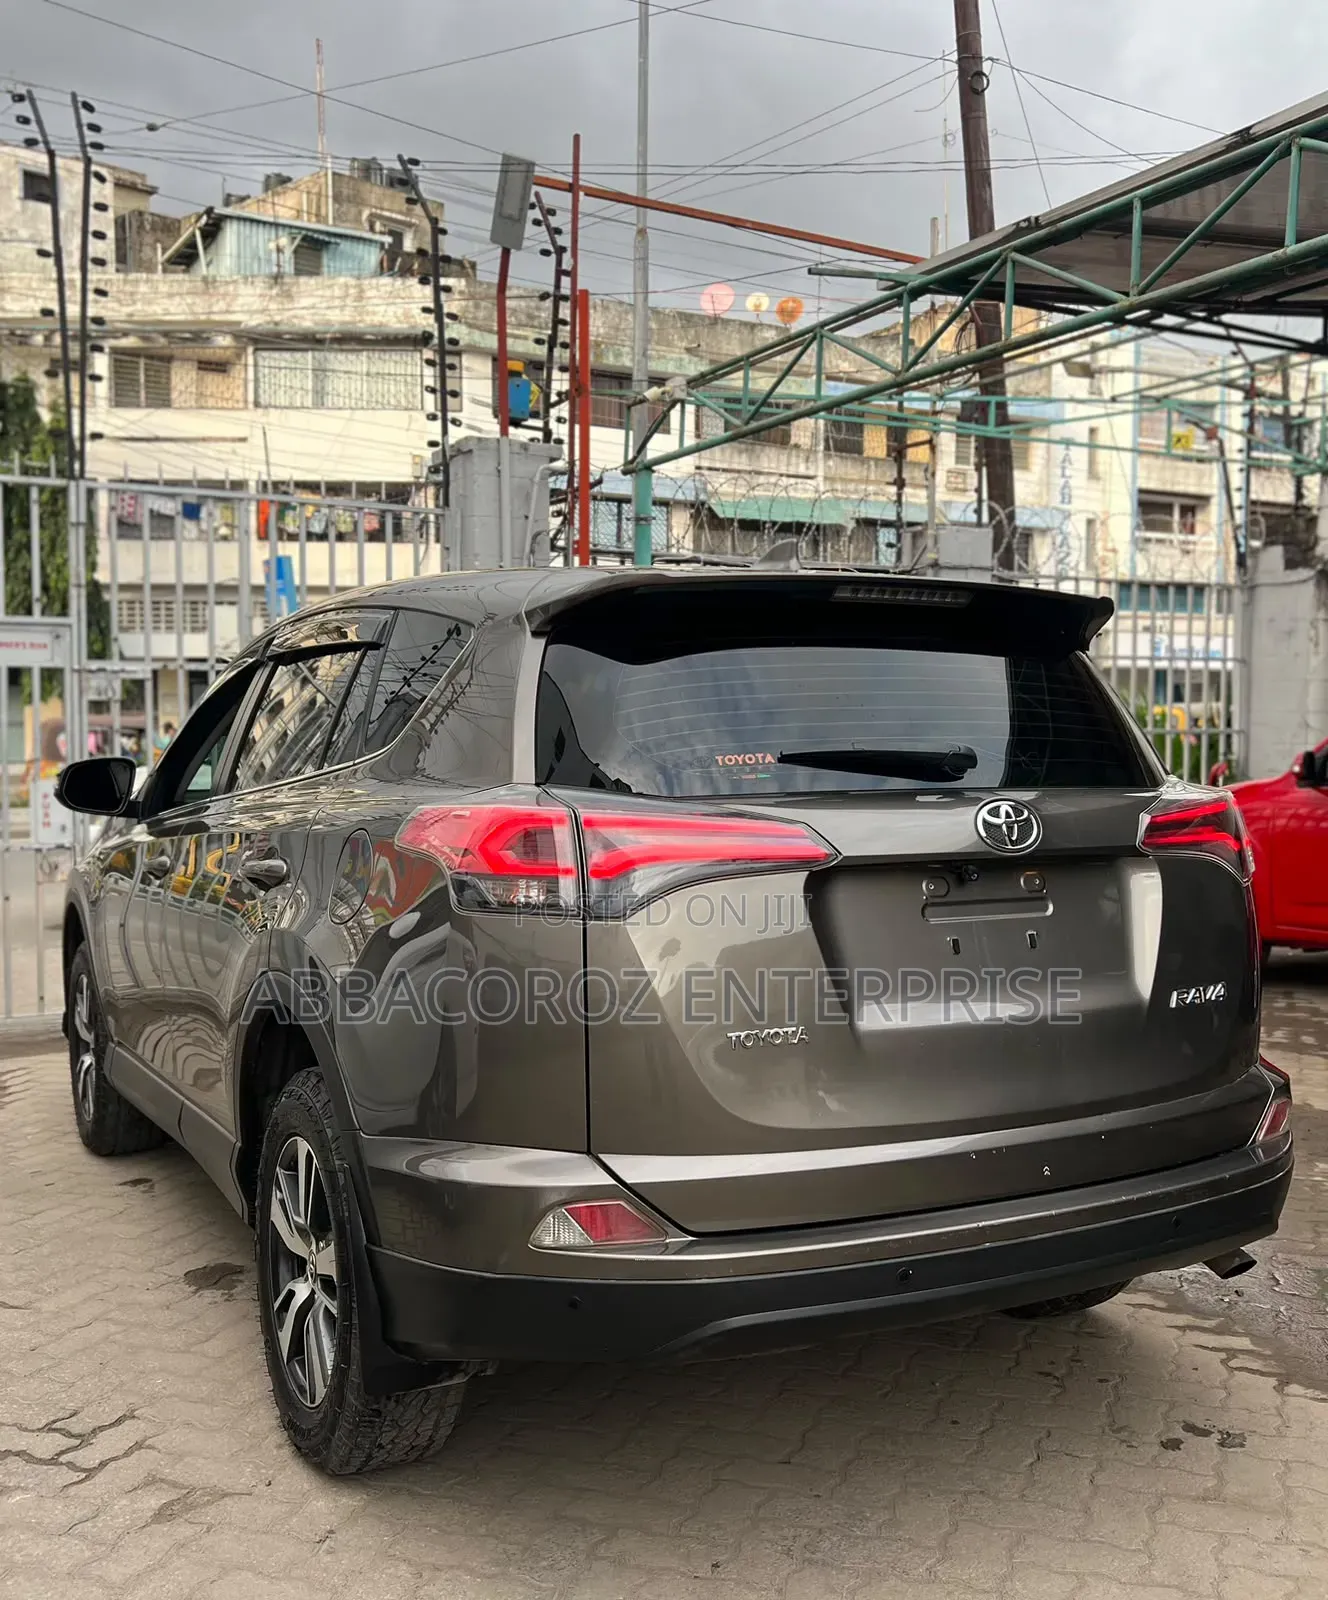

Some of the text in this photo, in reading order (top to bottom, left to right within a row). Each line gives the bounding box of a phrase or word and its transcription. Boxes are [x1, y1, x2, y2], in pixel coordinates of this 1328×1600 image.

[715, 752, 776, 766] TOYOTA
[1169, 981, 1227, 1008] RAV4
[726, 1026, 809, 1050] TOYOTA
